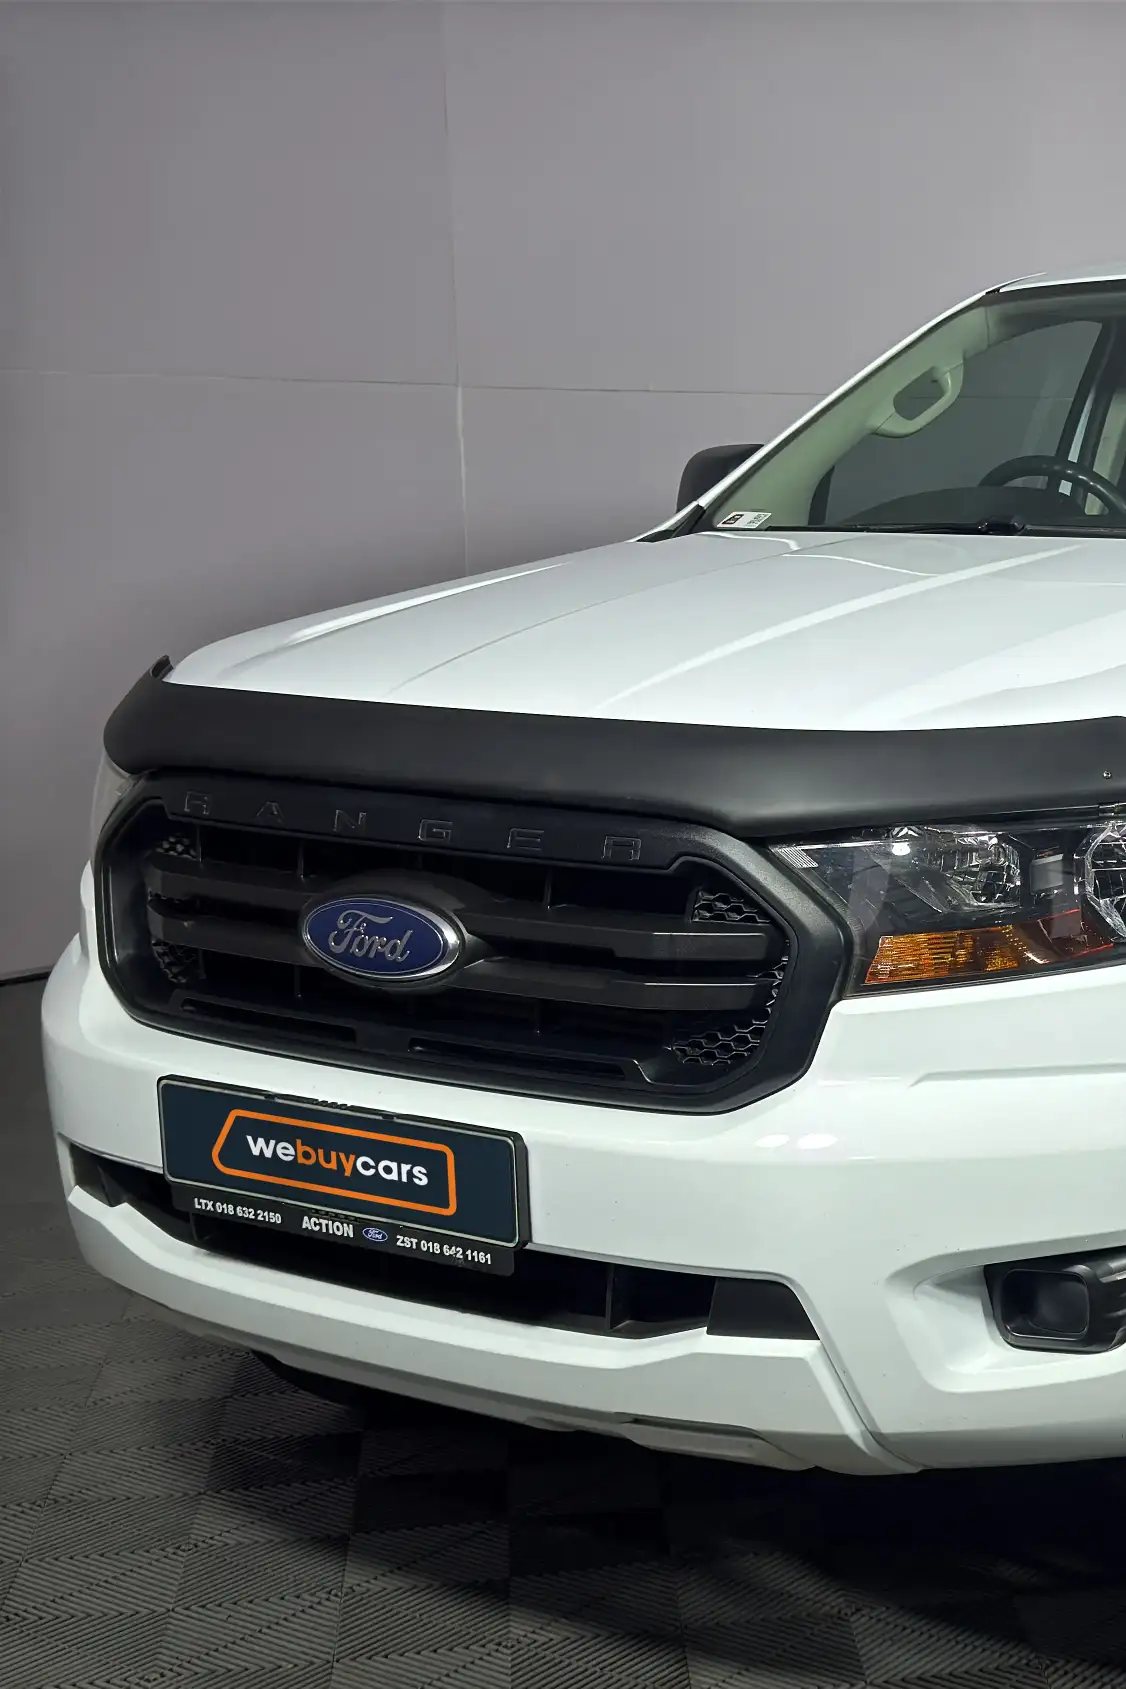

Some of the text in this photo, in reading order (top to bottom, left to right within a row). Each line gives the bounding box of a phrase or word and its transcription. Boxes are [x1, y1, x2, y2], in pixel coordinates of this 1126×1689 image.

[184, 791, 641, 861] RANGER
[328, 909, 413, 963] Ford
[246, 1134, 429, 1186] webuycars
[194, 1197, 282, 1225] LTX 018 632 2150
[302, 1215, 354, 1238] ACTION
[396, 1234, 492, 1265] ZST 018 642 1161
